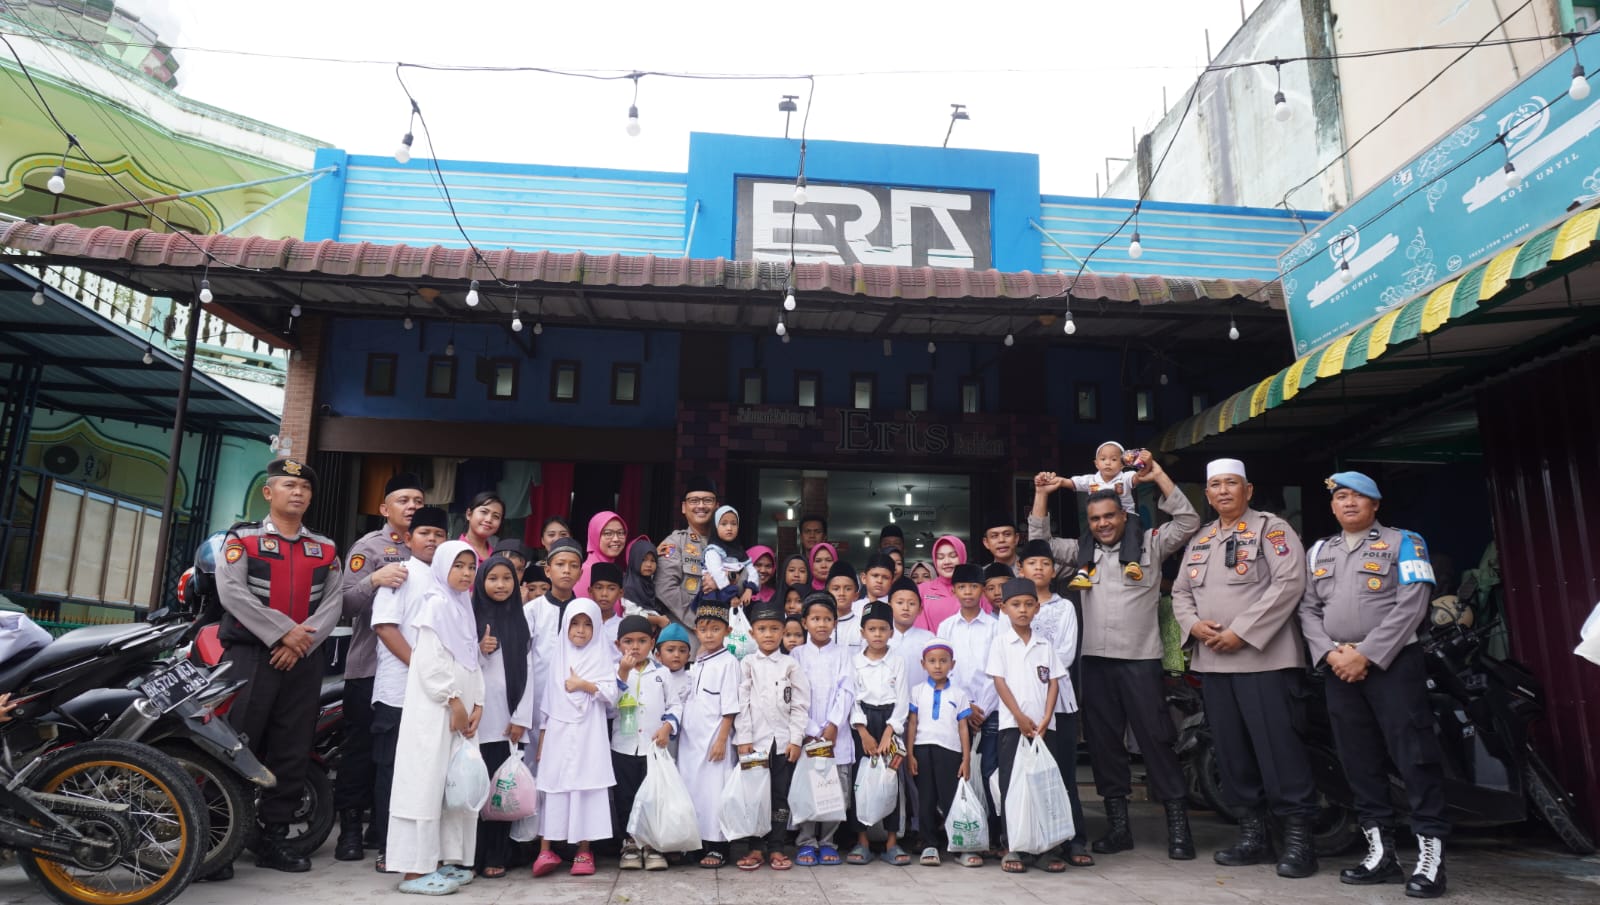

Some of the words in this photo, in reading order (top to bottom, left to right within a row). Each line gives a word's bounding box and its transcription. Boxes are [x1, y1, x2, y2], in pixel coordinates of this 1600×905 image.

[1500, 180, 1530, 203] ROTI
[1536, 153, 1579, 181] UNYIL
[1330, 289, 1349, 304] ROTI
[1352, 272, 1378, 291] UNYIL
[835, 408, 949, 453] Eris
[1362, 551, 1392, 559] POLRI
[154, 672, 179, 692] 5720
